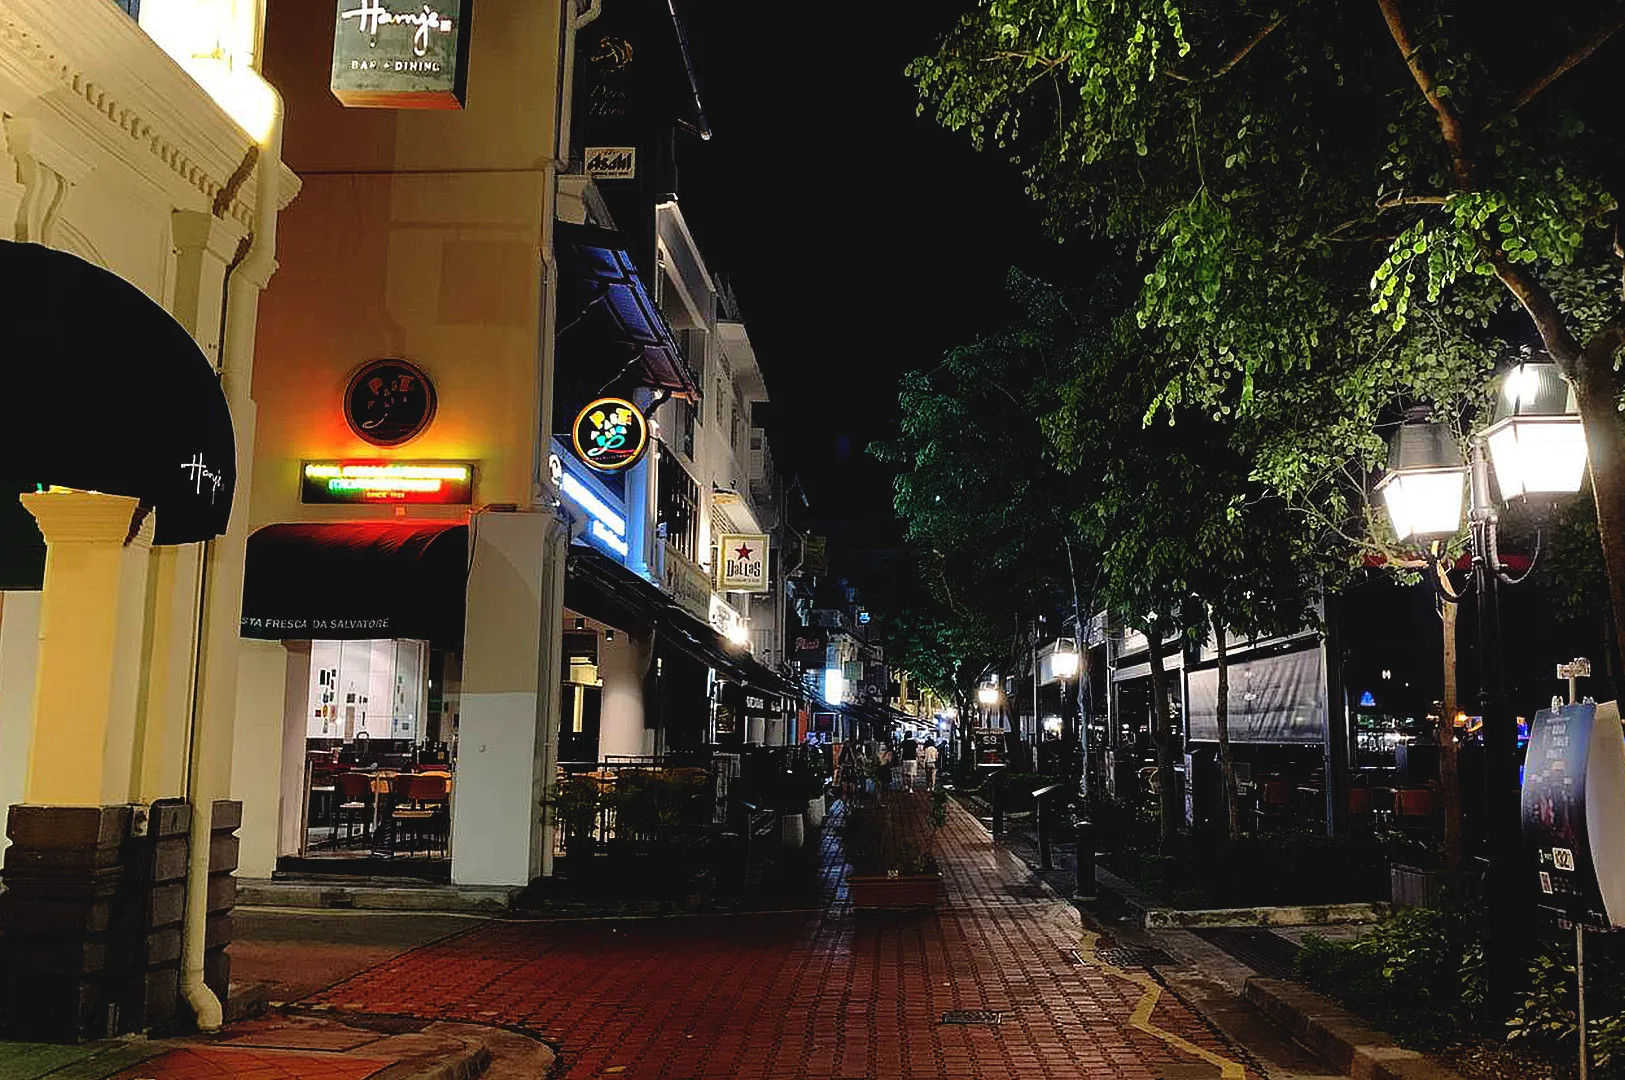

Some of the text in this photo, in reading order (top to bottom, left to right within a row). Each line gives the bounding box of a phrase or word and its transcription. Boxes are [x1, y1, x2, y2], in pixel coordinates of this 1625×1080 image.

[351, 60, 378, 70] BAR
[395, 60, 440, 71] DINING
[265, 618, 307, 629] FRESCA
[313, 619, 328, 629] DA
[330, 618, 389, 629] SALVATORE
